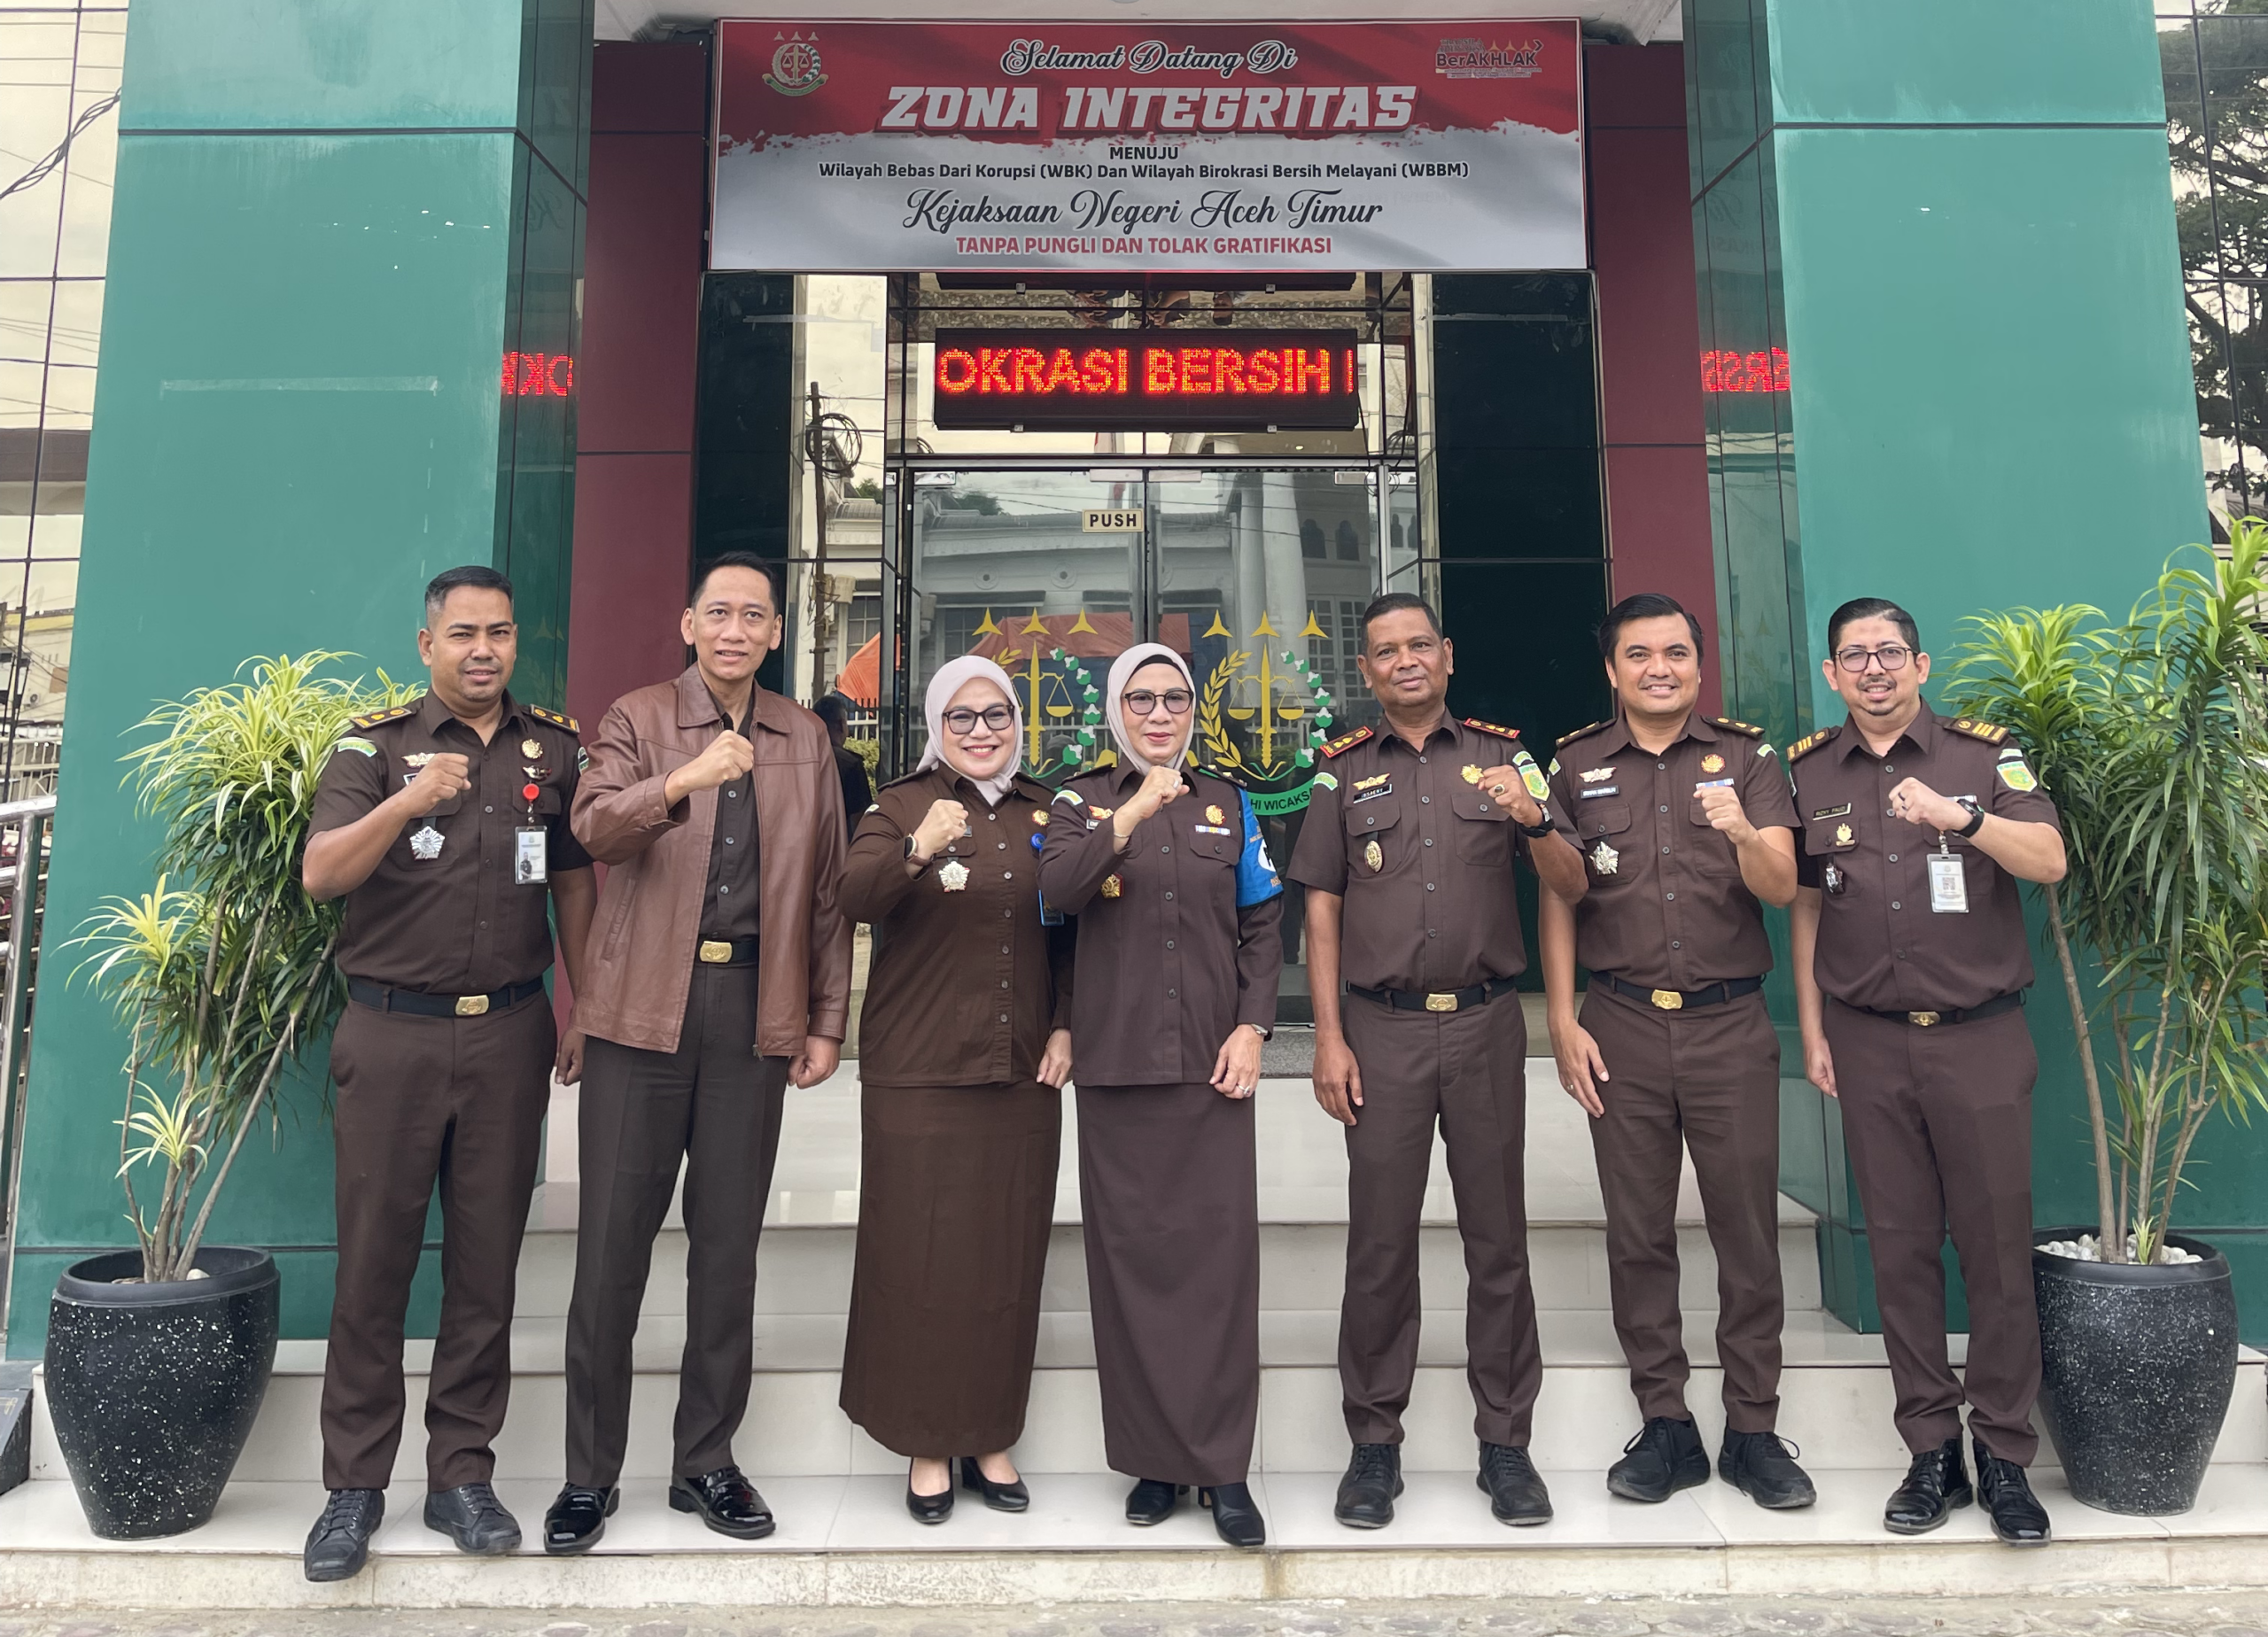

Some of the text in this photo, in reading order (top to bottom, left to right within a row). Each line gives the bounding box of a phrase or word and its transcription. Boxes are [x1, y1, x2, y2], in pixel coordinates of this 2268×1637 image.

[1002, 39, 1298, 77] Selamat Datang Di
[1436, 52, 1537, 66] BerAKHLAK
[880, 86, 1418, 128] ZONA INTEGRITAS
[1110, 147, 1178, 159] MENUJU
[819, 162, 1469, 181] Wilayah Bebas Dari Korupsi (WBK) Dan Wilayah Birokrasi Bersih Melayani (WBBM)
[903, 188, 1383, 234] Kejaksaan Negeri Aceh Timur
[956, 237, 1332, 254] TANPA PUNGLI DAN TOLAK GRATIFIKASI
[940, 348, 1129, 394] OKRASI
[1146, 348, 1331, 394] BERSIH
[1090, 514, 1137, 528] PUSH
